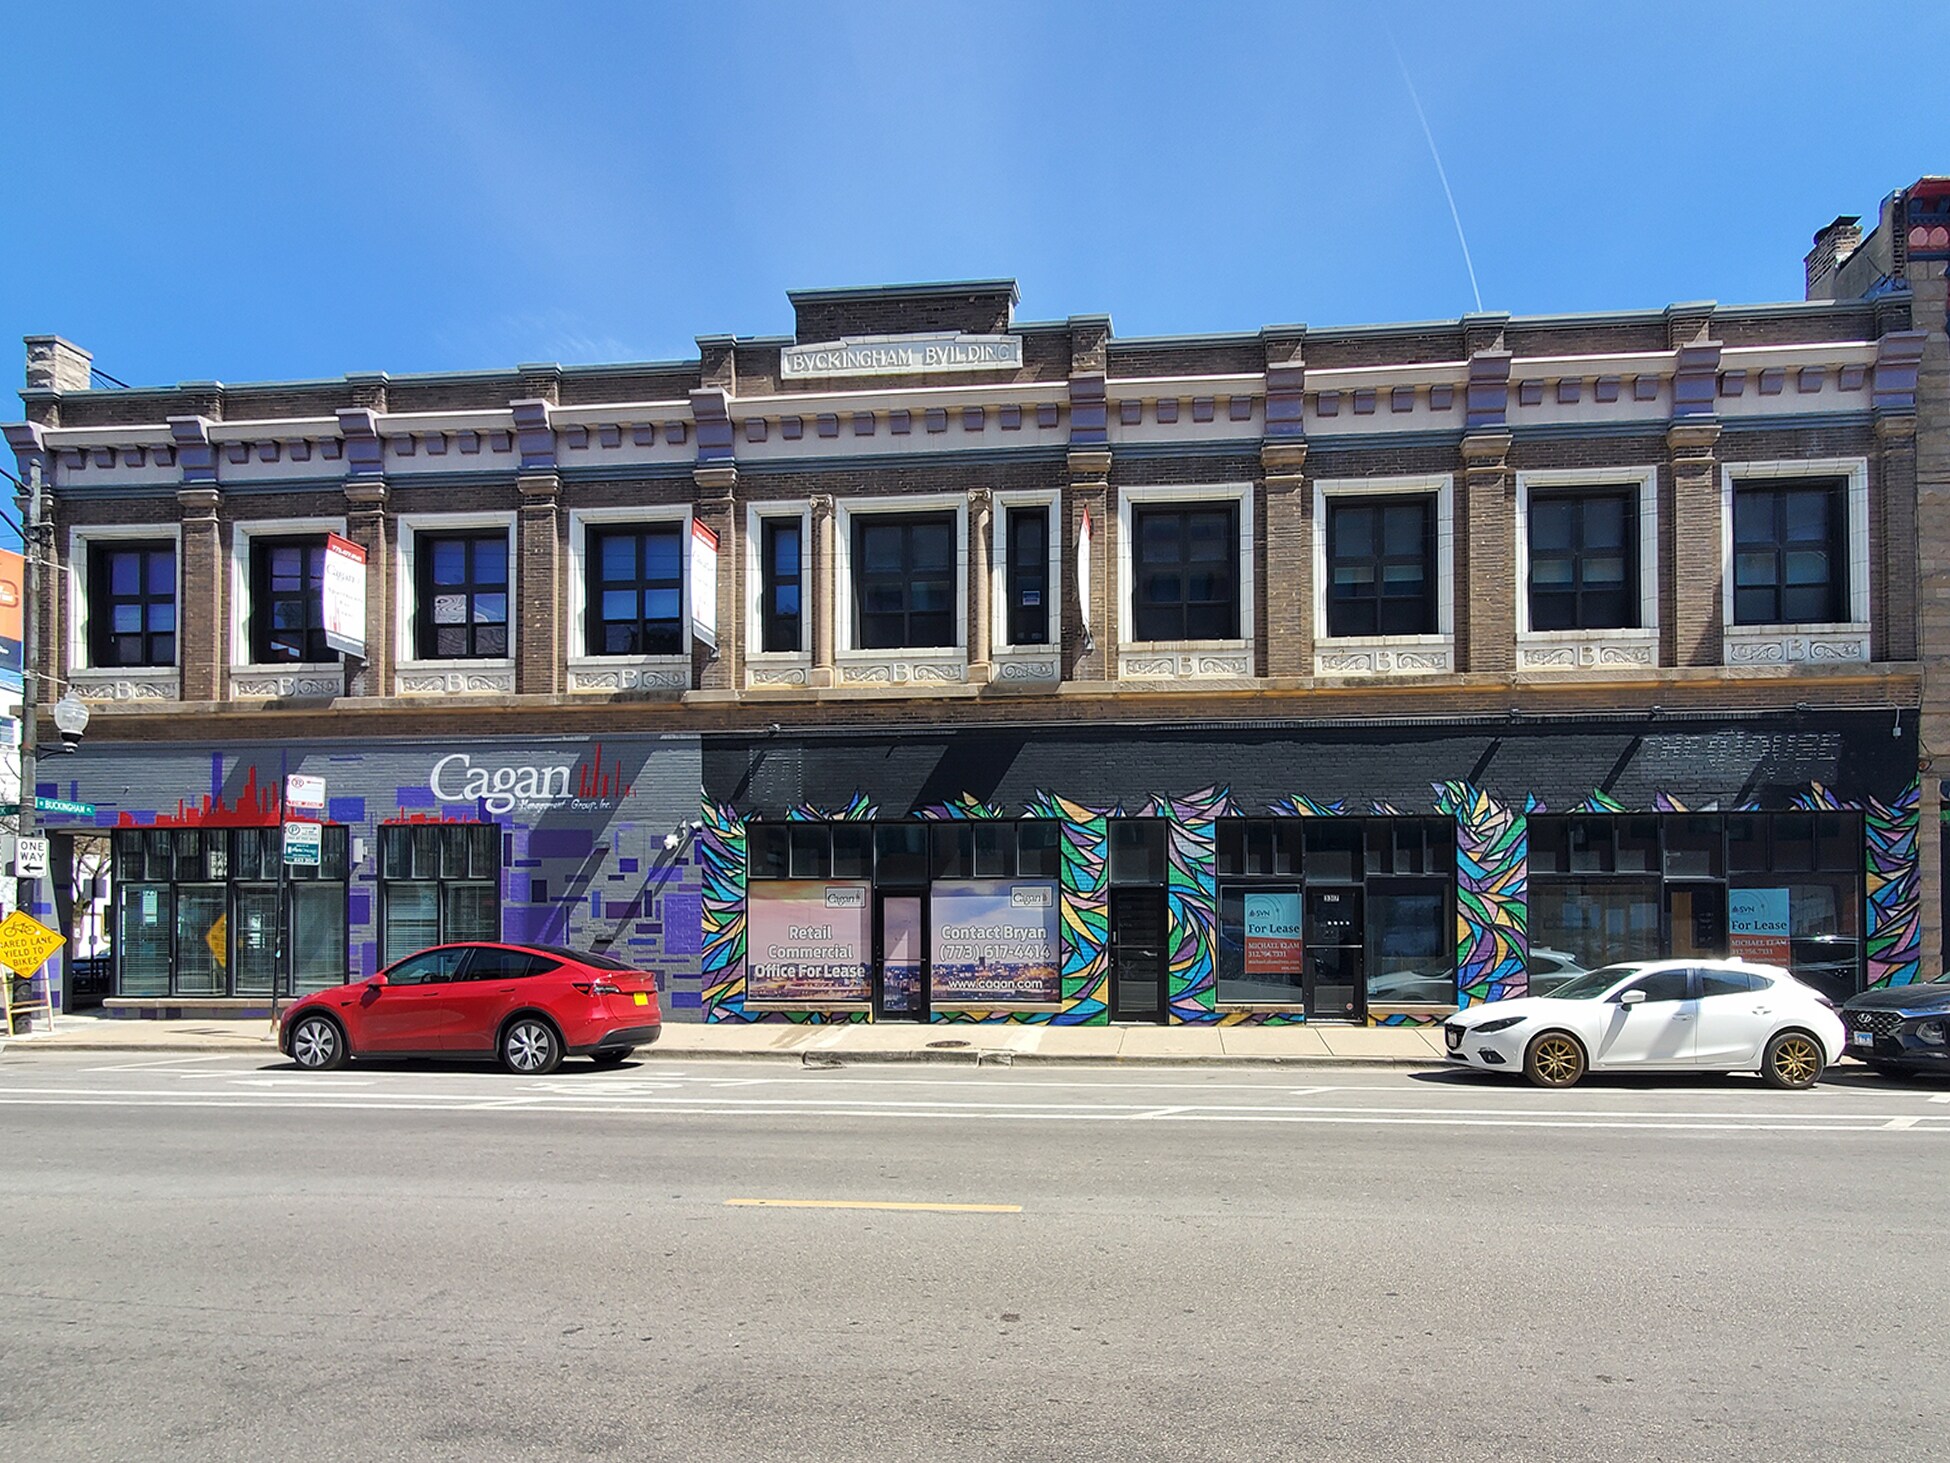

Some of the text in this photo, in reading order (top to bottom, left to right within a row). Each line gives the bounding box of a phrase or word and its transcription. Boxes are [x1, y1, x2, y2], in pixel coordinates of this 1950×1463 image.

[1579, 646, 1595, 666] B
[1787, 639, 1805, 661] B
[1178, 655, 1194, 676] B
[1375, 650, 1391, 671] B
[620, 669, 638, 689] B
[893, 662, 908, 682] B
[279, 677, 295, 697] B
[447, 673, 464, 692] B
[116, 681, 132, 699] B
[430, 754, 574, 813] Cagan
[45, 800, 85, 813] BUCKINGHAM
[20, 841, 45, 852] ONE
[20, 852, 45, 862] WAY
[827, 893, 855, 906] Cagan
[1013, 892, 1041, 905] Cagan
[1256, 909, 1270, 917] SVN
[1740, 905, 1755, 913] SVN
[1248, 924, 1300, 934] For Lease
[1731, 920, 1788, 930] For Lease
[789, 925, 832, 940] Retail
[941, 925, 1047, 942] Contact Bryan
[30, 935, 54, 946] LANE
[4, 946, 44, 958] YIELD TO
[768, 944, 853, 959] Commercial
[939, 944, 1051, 961] (773) 617-4414
[12, 956, 39, 967] BIKES
[754, 964, 866, 978] Office For Lease
[948, 980, 1043, 990] www.cagan.com
